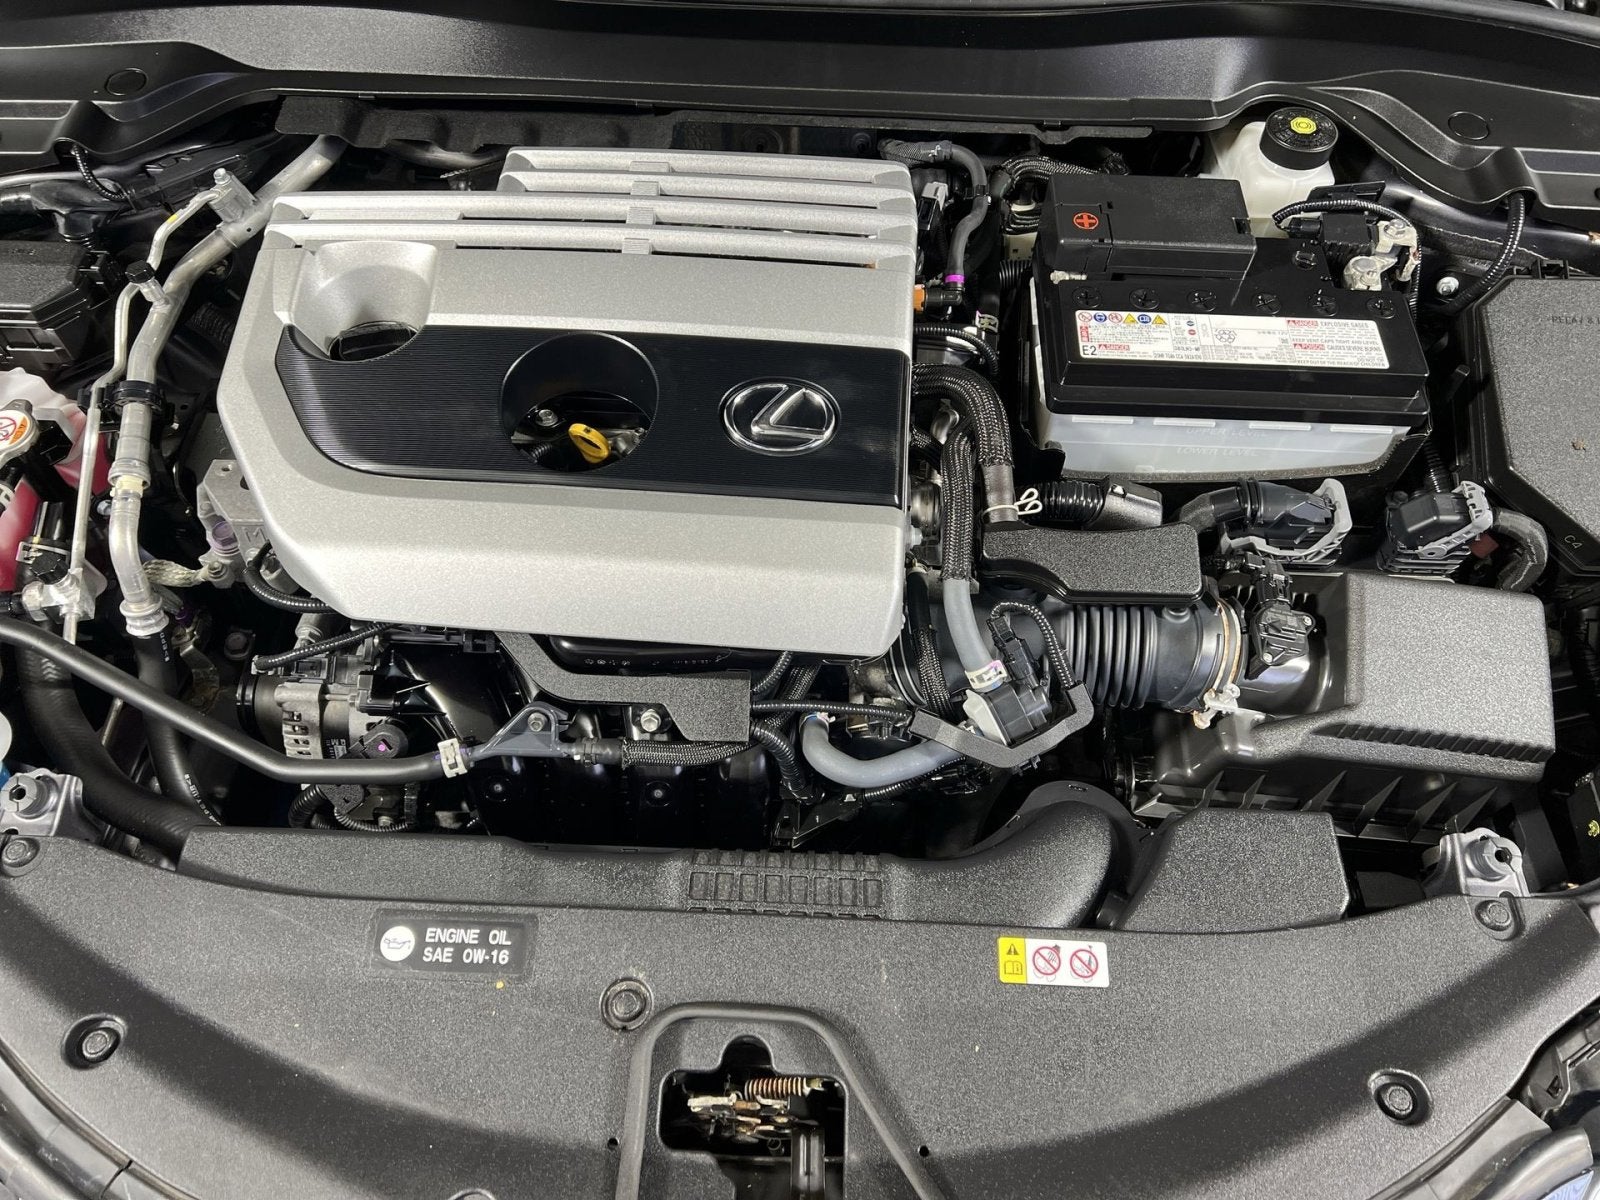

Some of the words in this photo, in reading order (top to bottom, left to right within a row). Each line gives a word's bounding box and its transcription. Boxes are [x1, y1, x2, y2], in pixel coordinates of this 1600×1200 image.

[1082, 345, 1097, 356] E2
[1186, 427, 1227, 436] UPPER
[1231, 429, 1267, 438] LEVEL
[1176, 447, 1219, 456] LOWER
[1222, 449, 1259, 457] LEVEL
[425, 927, 480, 944] ENGINE
[488, 929, 512, 946] OIL
[422, 947, 454, 963] SAE
[462, 949, 509, 965] 0W-16
